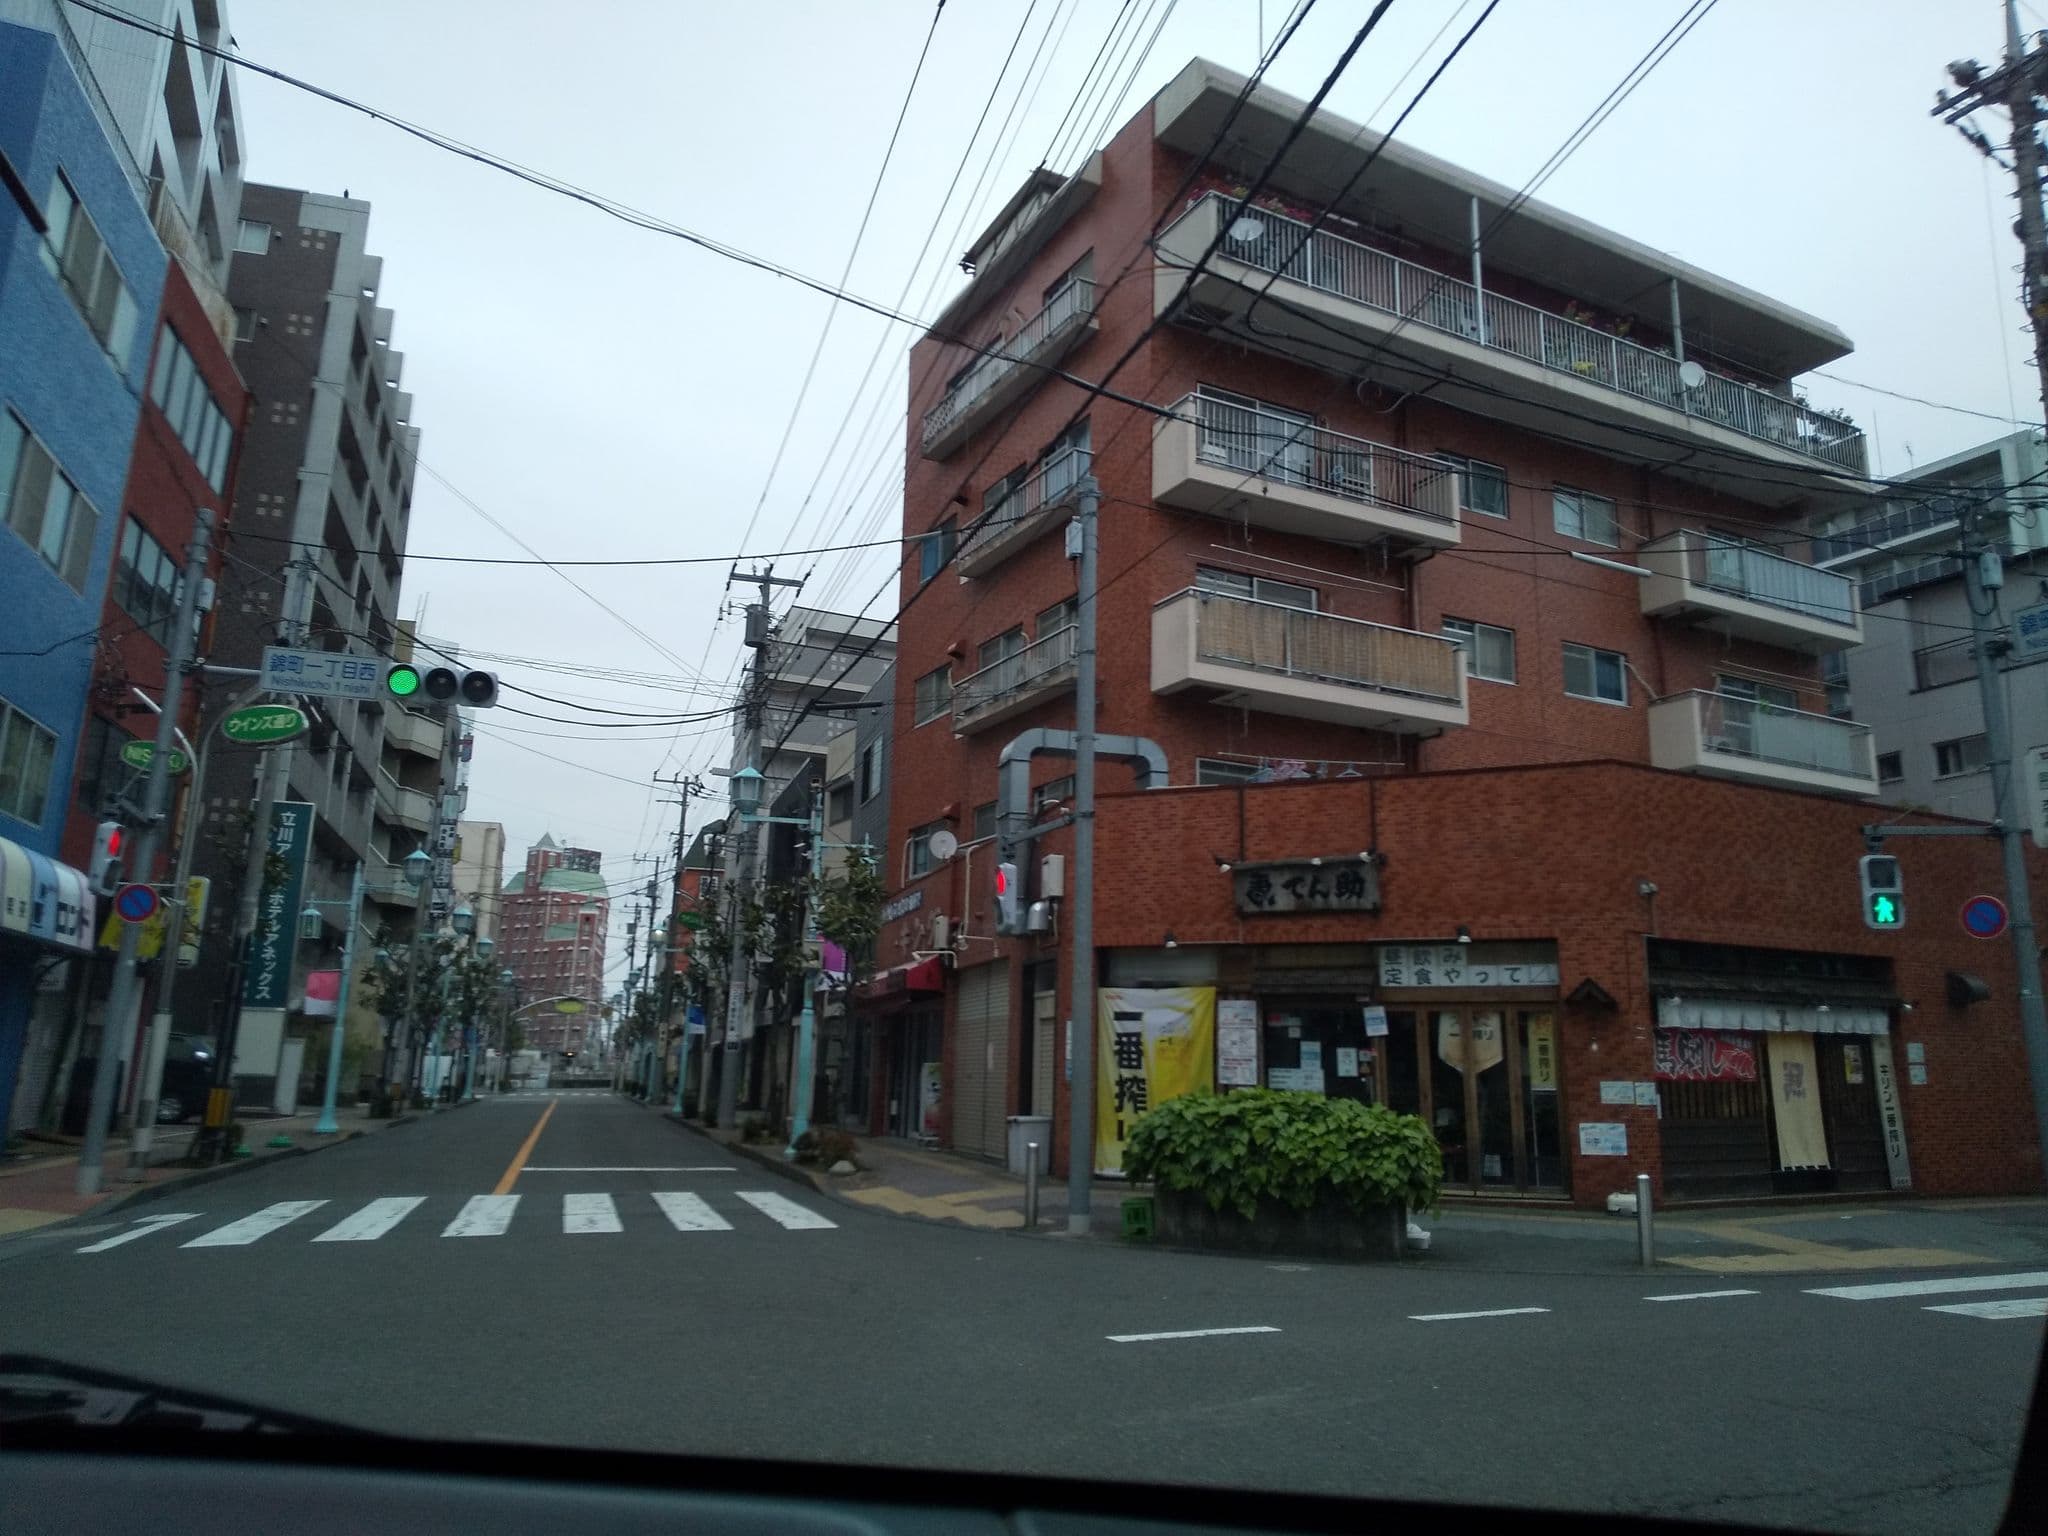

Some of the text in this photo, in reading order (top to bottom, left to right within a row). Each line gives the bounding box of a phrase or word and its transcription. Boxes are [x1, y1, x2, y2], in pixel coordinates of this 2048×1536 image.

[269, 653, 377, 681] 錦町一丁目西
[229, 712, 298, 733] ウインズ通り
[254, 811, 297, 1000] 立川アホテルアネックス
